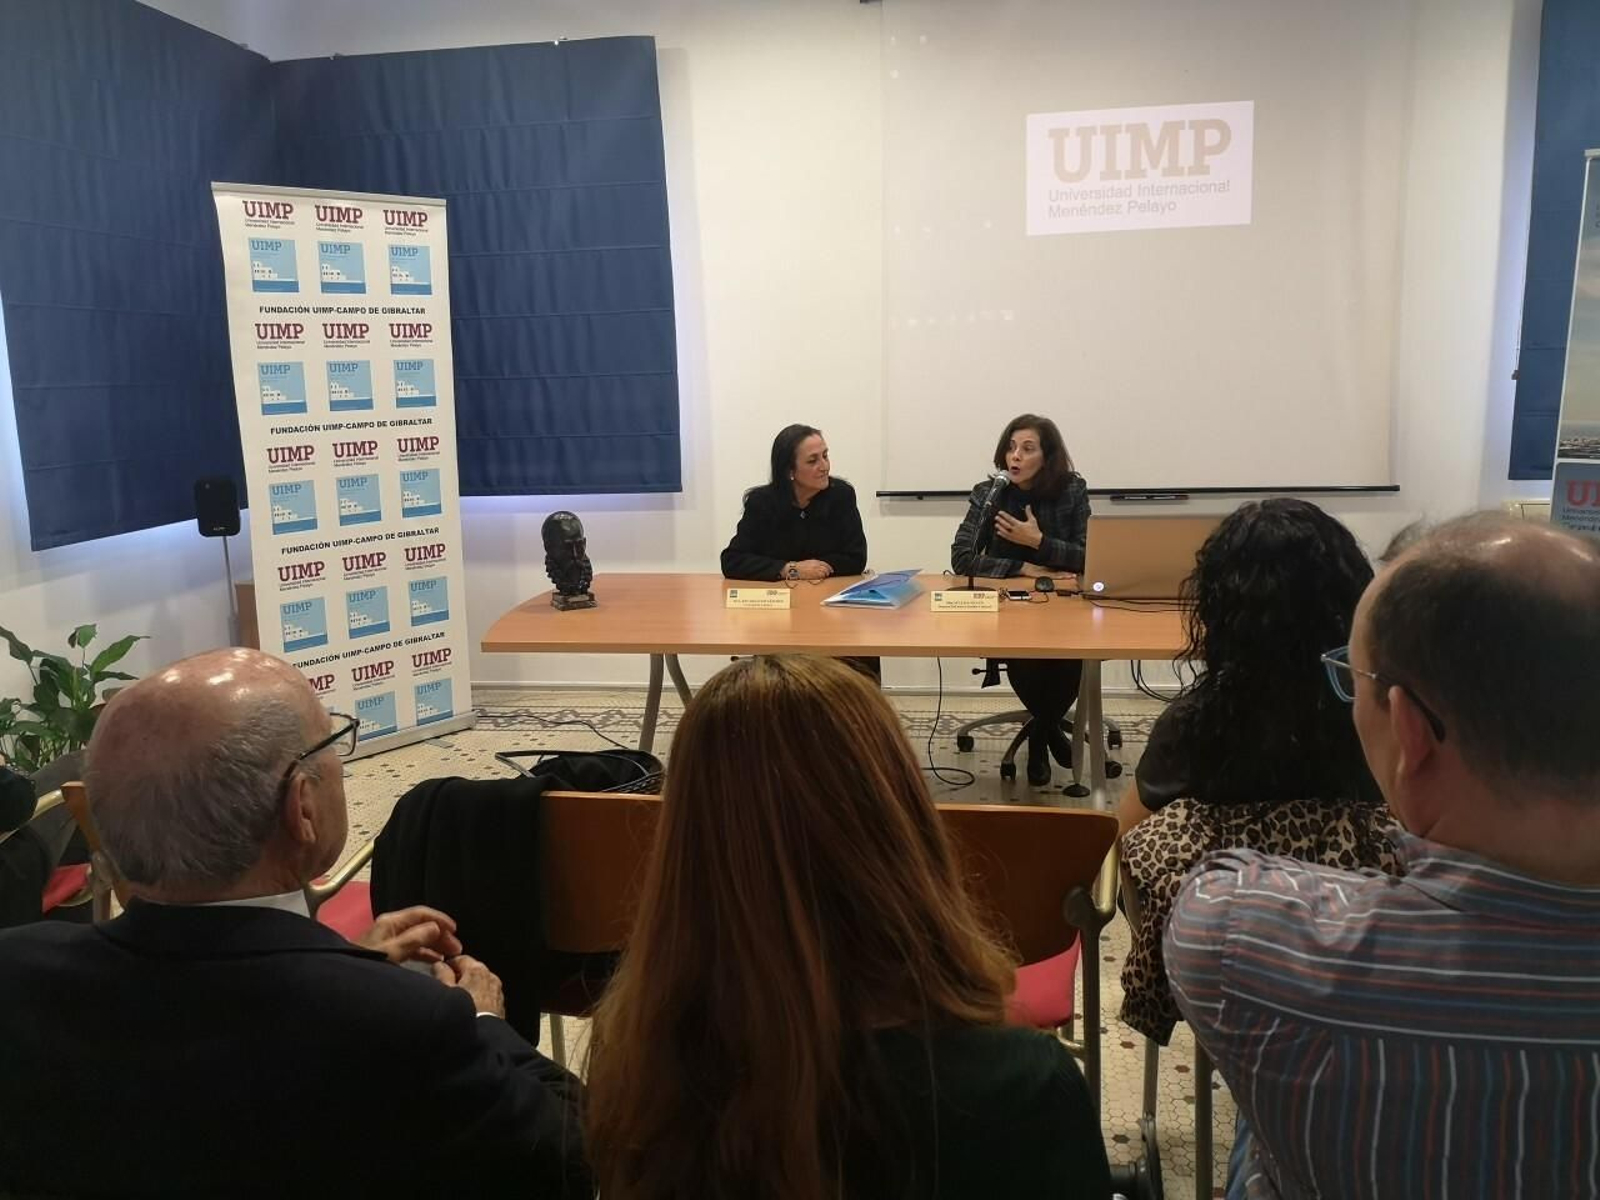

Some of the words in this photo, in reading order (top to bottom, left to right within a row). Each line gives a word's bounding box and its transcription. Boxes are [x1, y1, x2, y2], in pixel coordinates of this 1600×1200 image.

[1047, 118, 1232, 184] UIMP
[1048, 184, 1132, 203] Universidad
[1137, 179, 1231, 198] Internacional
[242, 200, 294, 220] UIMP
[314, 204, 363, 224] UIMP
[1048, 202, 1122, 219] Menéndez
[1127, 199, 1177, 217] Pelayo
[382, 209, 428, 227] UIMP
[251, 240, 282, 251] UIMP
[320, 243, 351, 255] UIMP
[390, 246, 419, 257] UIMP
[259, 305, 310, 314] FUNDACIÓN
[368, 307, 380, 315] DE
[381, 307, 426, 315] GIBRALTAR
[254, 323, 304, 340] UIMP
[321, 323, 370, 339] UIMP
[388, 323, 433, 339] UIMP
[260, 364, 291, 375] UIMP
[329, 362, 359, 373] UIMP
[396, 361, 423, 371] UIMP
[270, 423, 321, 435] FUNDACIÓN
[376, 420, 388, 428] DE
[389, 418, 433, 427] GIBRALTAR
[332, 440, 378, 458] UIMP
[397, 436, 440, 453] UIMP
[266, 445, 315, 464] UIMP
[339, 477, 368, 488] UIMP
[402, 471, 429, 482] UIMP
[271, 483, 302, 495] UIMP
[281, 541, 331, 555] FUNDACIÓN
[385, 532, 396, 541] DE
[397, 526, 440, 538] GIBRALTAR
[404, 543, 446, 562] UIMP
[342, 552, 387, 572] UIMP
[277, 561, 325, 582] UIMP
[410, 579, 437, 592] UIMP
[349, 590, 377, 603] UIMP
[282, 601, 312, 615] UIMP
[393, 639, 403, 648] DE
[404, 631, 446, 645] GIBRALTAR
[411, 647, 452, 668] UIMP
[351, 660, 395, 682] UIMP
[308, 673, 336, 691] MP
